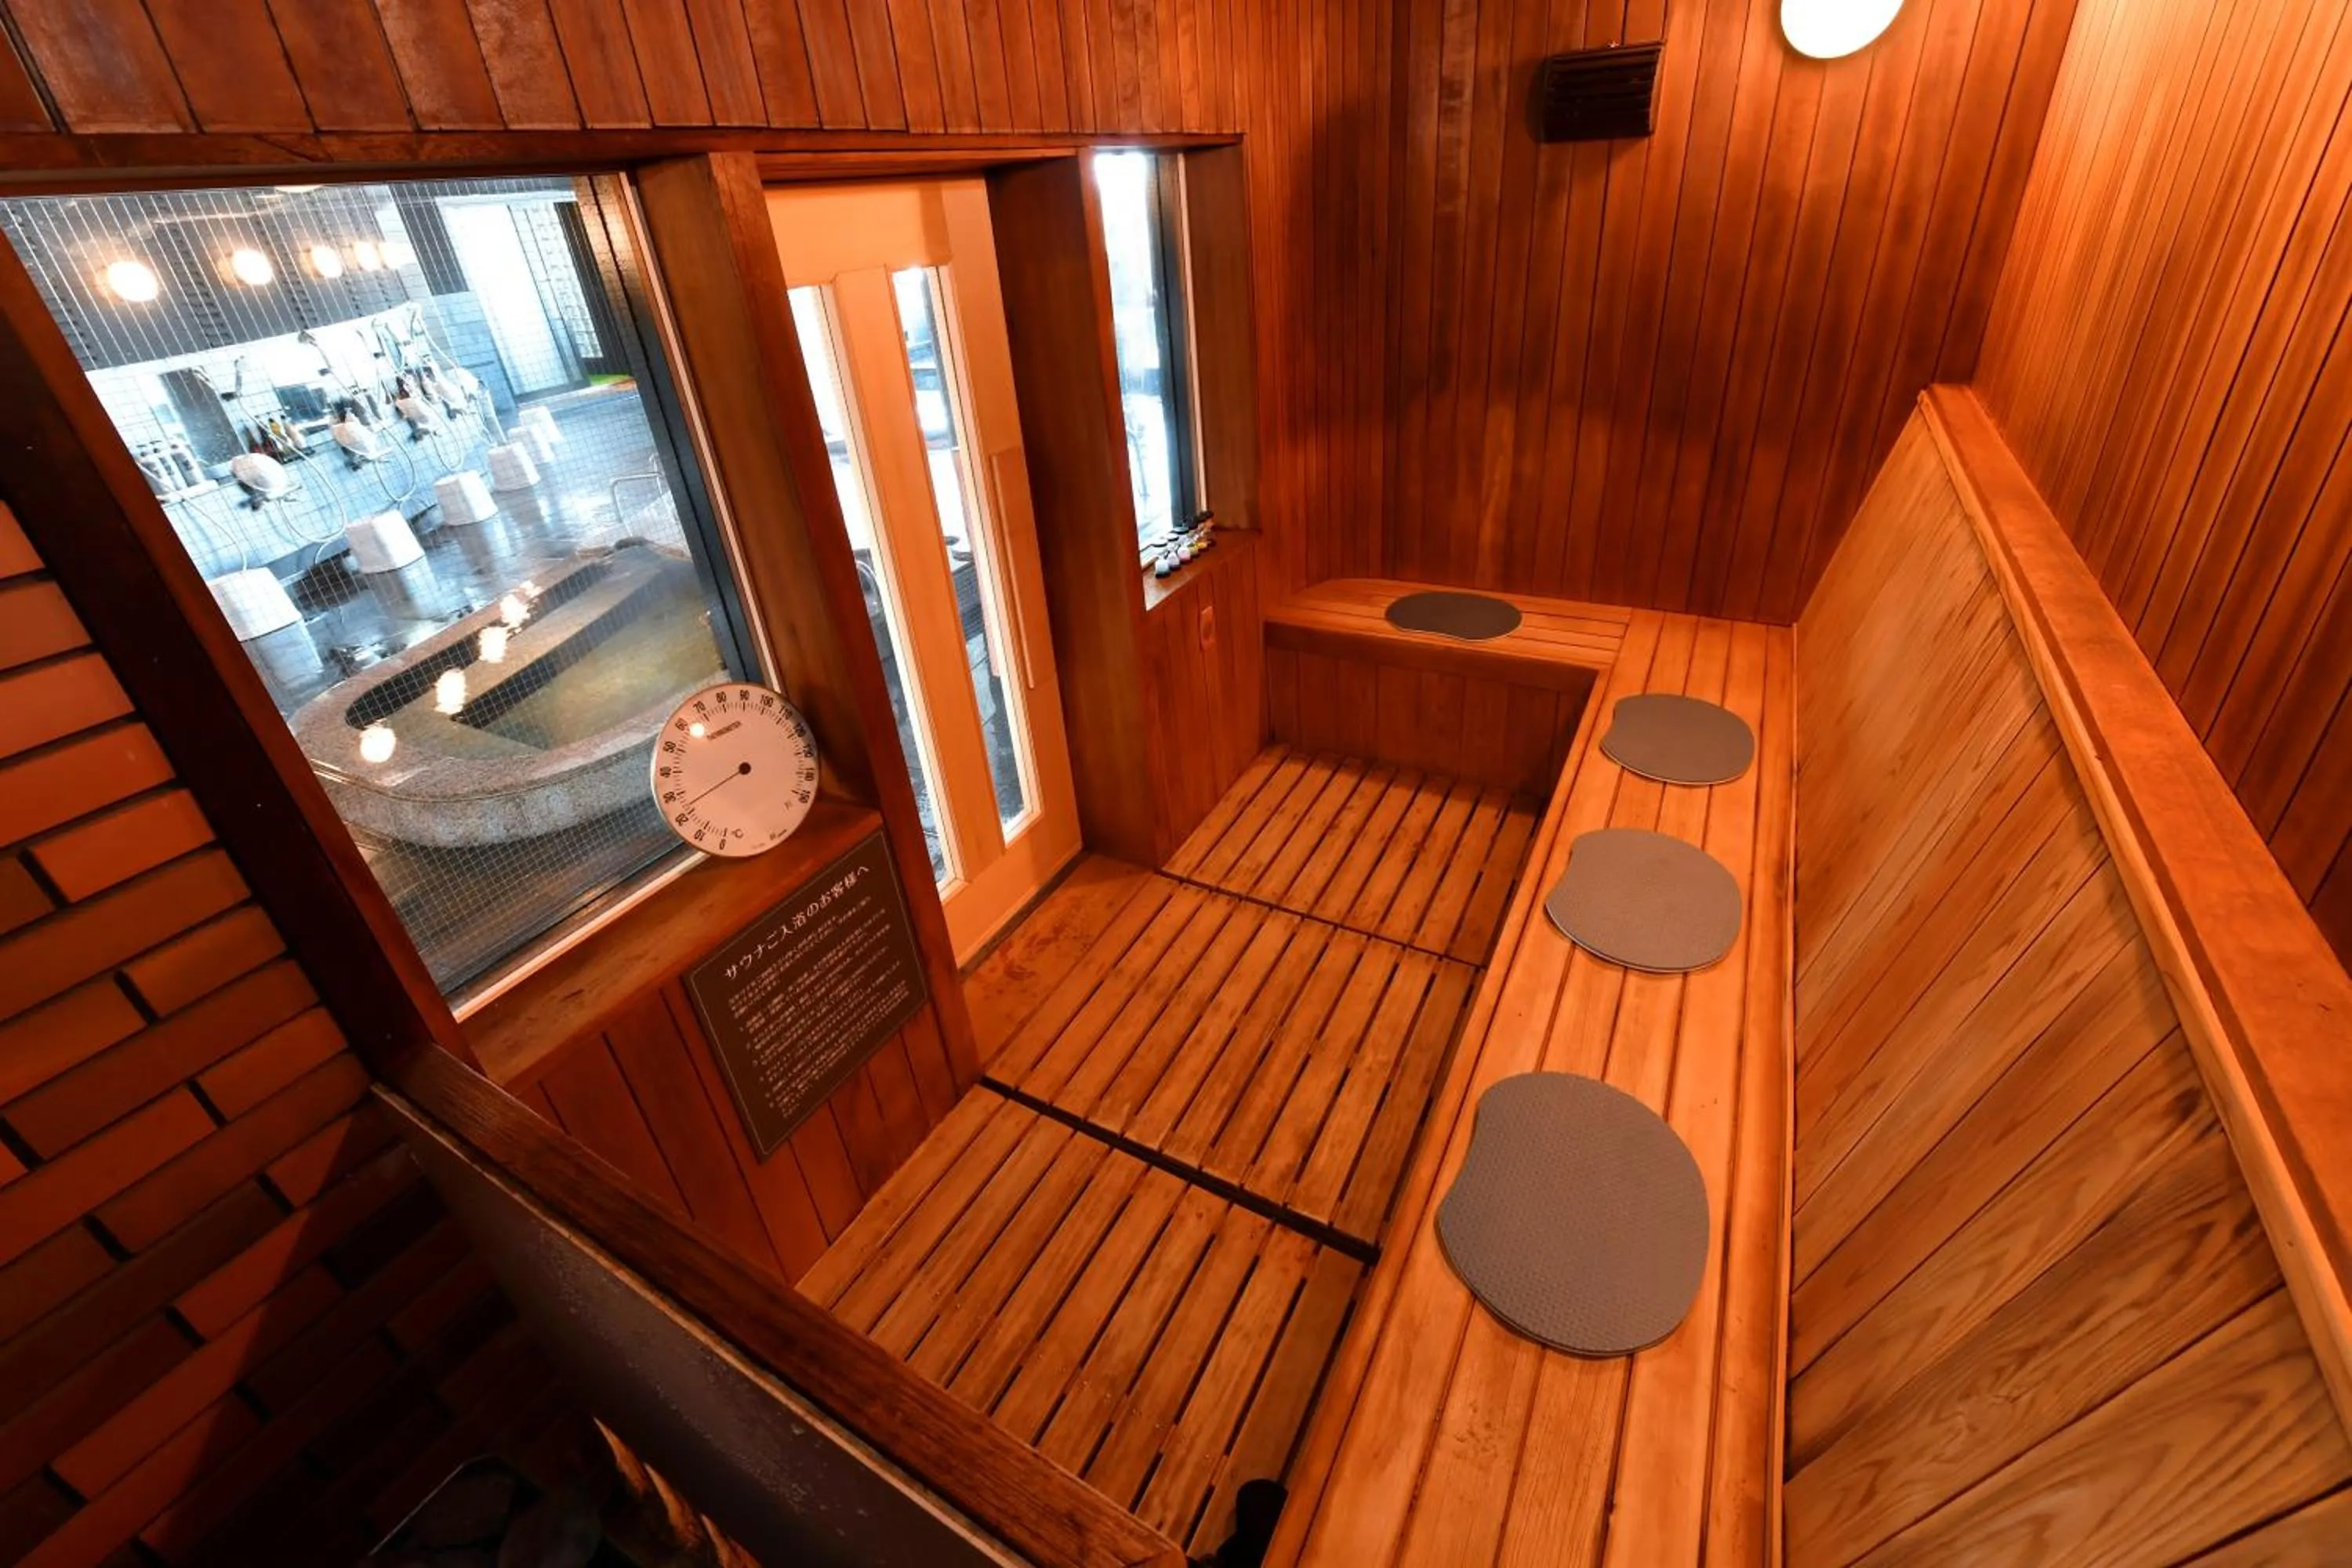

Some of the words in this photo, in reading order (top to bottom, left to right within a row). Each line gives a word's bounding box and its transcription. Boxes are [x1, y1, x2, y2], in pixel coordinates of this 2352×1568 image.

[693, 701, 706, 713] 70
[760, 695, 774, 707] 100
[779, 705, 793, 720] 110
[663, 742, 677, 753] 50
[675, 813, 688, 826] 20
[694, 829, 706, 841] 10
[719, 839, 726, 850] 0
[724, 866, 869, 980] サウナご入浴のお客様へ
